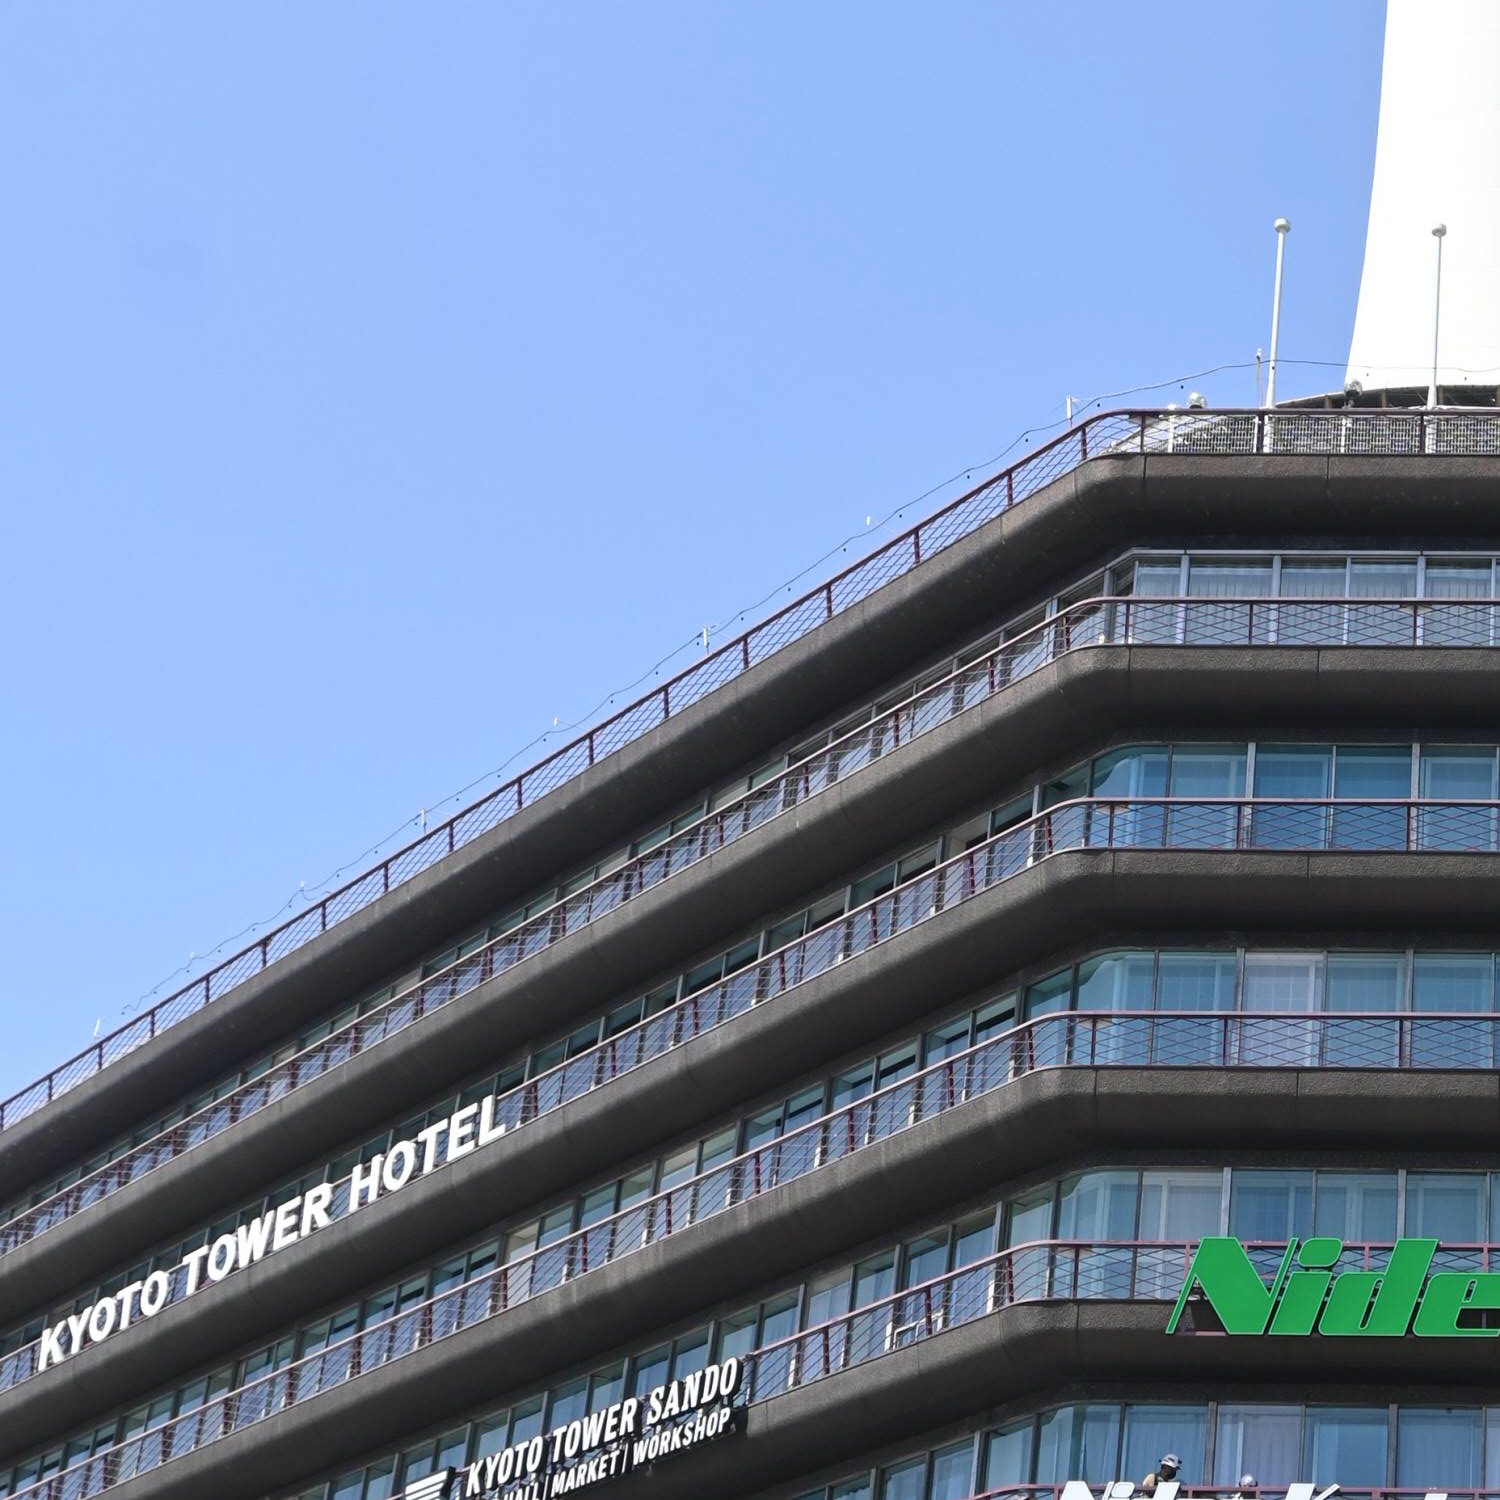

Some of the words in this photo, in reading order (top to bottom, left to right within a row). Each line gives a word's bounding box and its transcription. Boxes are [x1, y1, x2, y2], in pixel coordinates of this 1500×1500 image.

[38, 1270, 171, 1371] KYOTO
[182, 1183, 335, 1296] TOWER
[348, 1094, 506, 1212] HOTEL
[465, 1435, 544, 1497] KYOTO
[552, 1397, 639, 1463] TOWER
[646, 1357, 738, 1426] SANDO
[551, 1449, 620, 1498] MARKET
[632, 1406, 732, 1467] WORKSHOP
